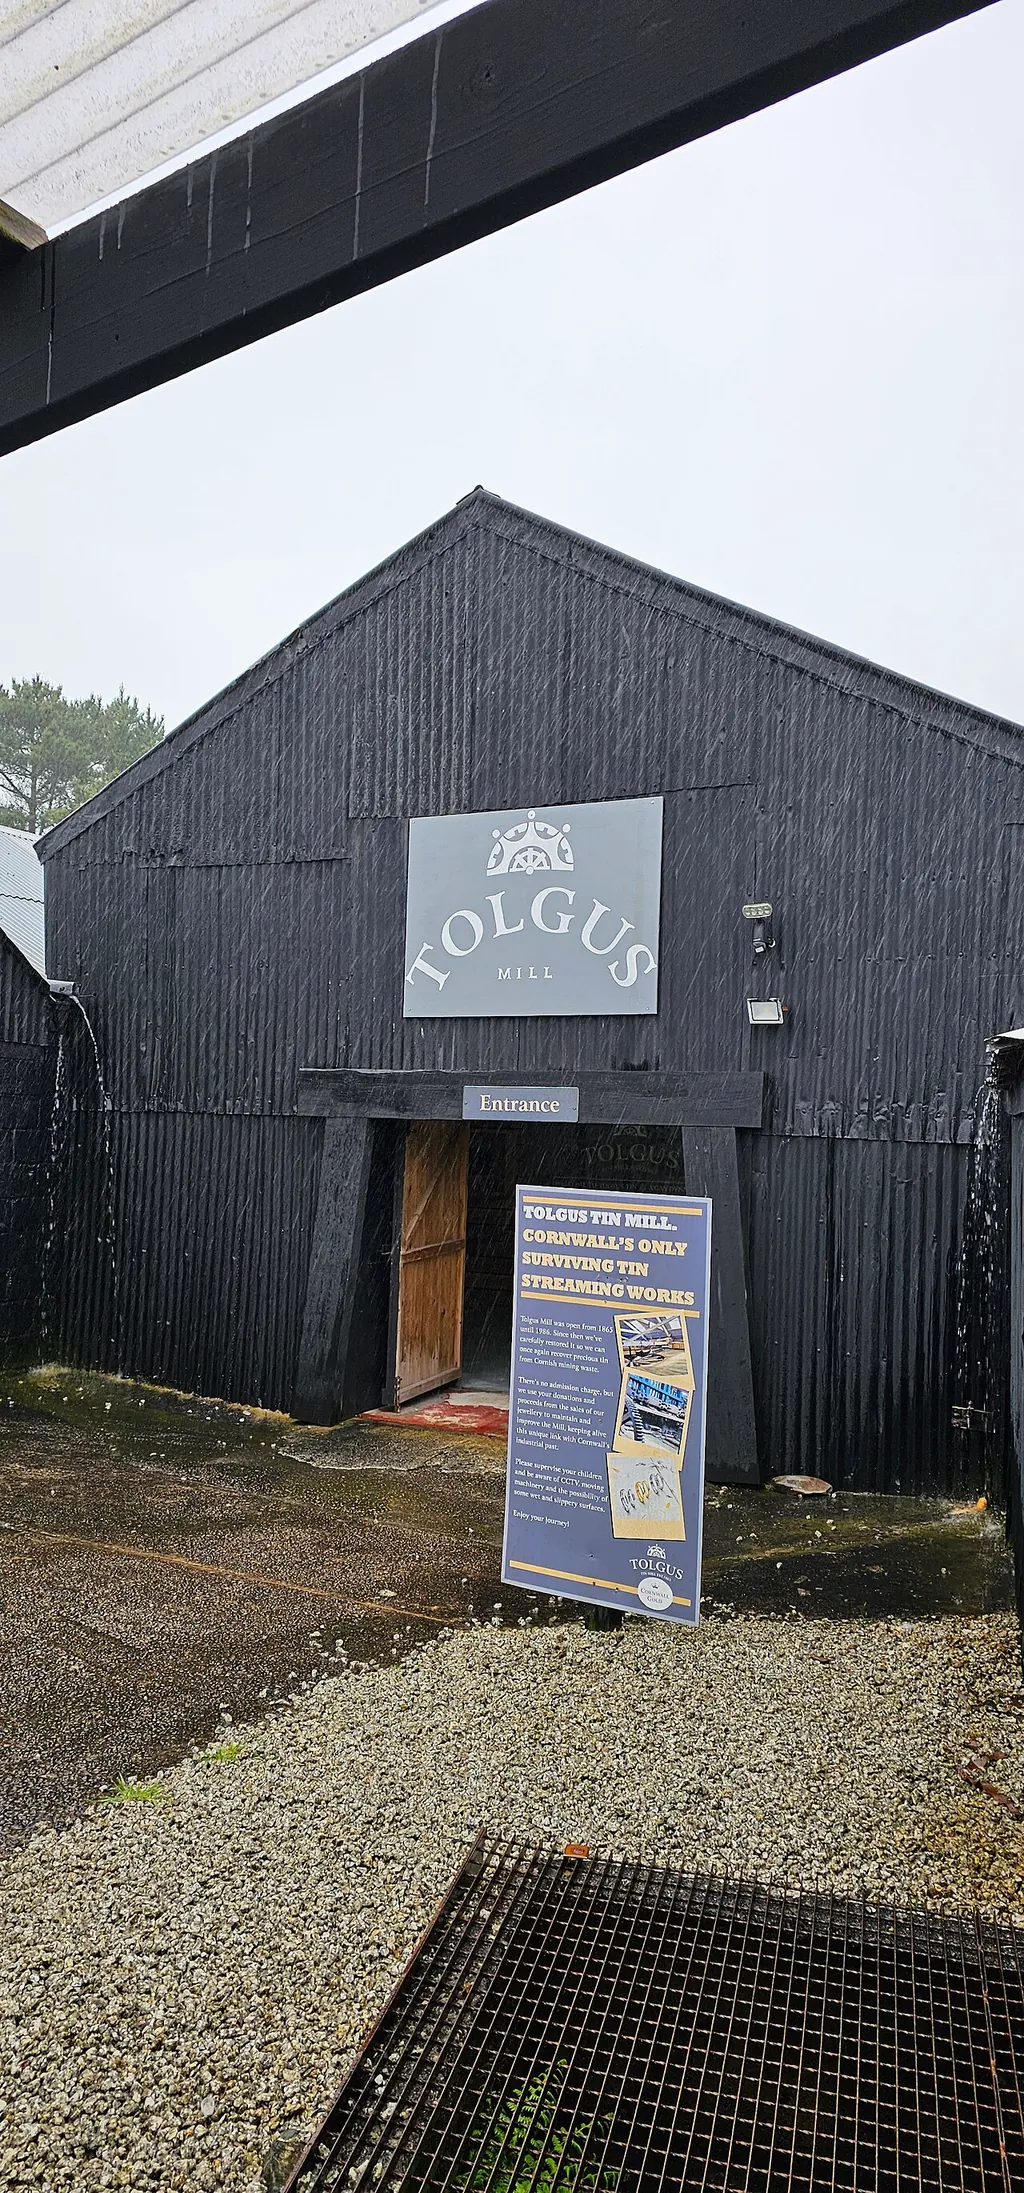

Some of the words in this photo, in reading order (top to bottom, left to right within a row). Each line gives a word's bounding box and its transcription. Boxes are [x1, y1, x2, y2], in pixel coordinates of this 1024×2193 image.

[406, 886, 658, 991] TOLGUS
[497, 966, 553, 980] MILL
[479, 1094, 560, 1113] Entrance
[523, 1206, 588, 1223] TOLGUS
[590, 1211, 621, 1226] TIN
[625, 1214, 678, 1231] MILL.
[522, 1229, 634, 1251] CORNWALL'S
[638, 1239, 688, 1256] ONLY
[522, 1252, 614, 1273] SURVIVING
[617, 1261, 649, 1277] TIN
[521, 1274, 624, 1297] STREAMING
[627, 1285, 695, 1305] WORKS
[520, 1316, 538, 1324] Tolgus
[566, 1322, 580, 1330] open
[582, 1323, 596, 1331] from
[536, 1328, 551, 1336] 1986.
[520, 1337, 544, 1345] carefully
[545, 1340, 569, 1348] restored
[519, 1355, 533, 1363] from
[534, 1357, 557, 1366] Cornish
[558, 1361, 579, 1371] mining
[580, 1365, 599, 1373] waste.
[534, 1348, 549, 1356] again
[573, 1353, 598, 1362] precious
[518, 1376, 539, 1385] There's
[549, 1382, 579, 1391] admission
[580, 1386, 602, 1396] charge,
[517, 1398, 542, 1407] proceeds
[544, 1401, 557, 1409] from
[570, 1405, 584, 1413] sales
[553, 1392, 582, 1402] donations
[551, 1414, 578, 1422] maintain
[552, 1422, 566, 1431] Mill,
[567, 1425, 591, 1436] keeping
[528, 1430, 548, 1439] unique
[549, 1432, 561, 1440] link
[563, 1435, 577, 1443] with
[578, 1438, 610, 1449] Cornwall's
[515, 1458, 533, 1467] Please
[534, 1463, 561, 1472] supervise
[577, 1470, 602, 1480] children
[527, 1470, 534, 1478] be
[560, 1477, 580, 1487] CCTV,
[581, 1482, 604, 1493] moving
[514, 1480, 544, 1490] machinery
[569, 1489, 600, 1502] possibility
[554, 1496, 578, 1508] slippery
[579, 1502, 605, 1512] surfaces.
[513, 1509, 530, 1520] Enjoy
[531, 1514, 544, 1522] your
[629, 1558, 684, 1580] TOLGUS
